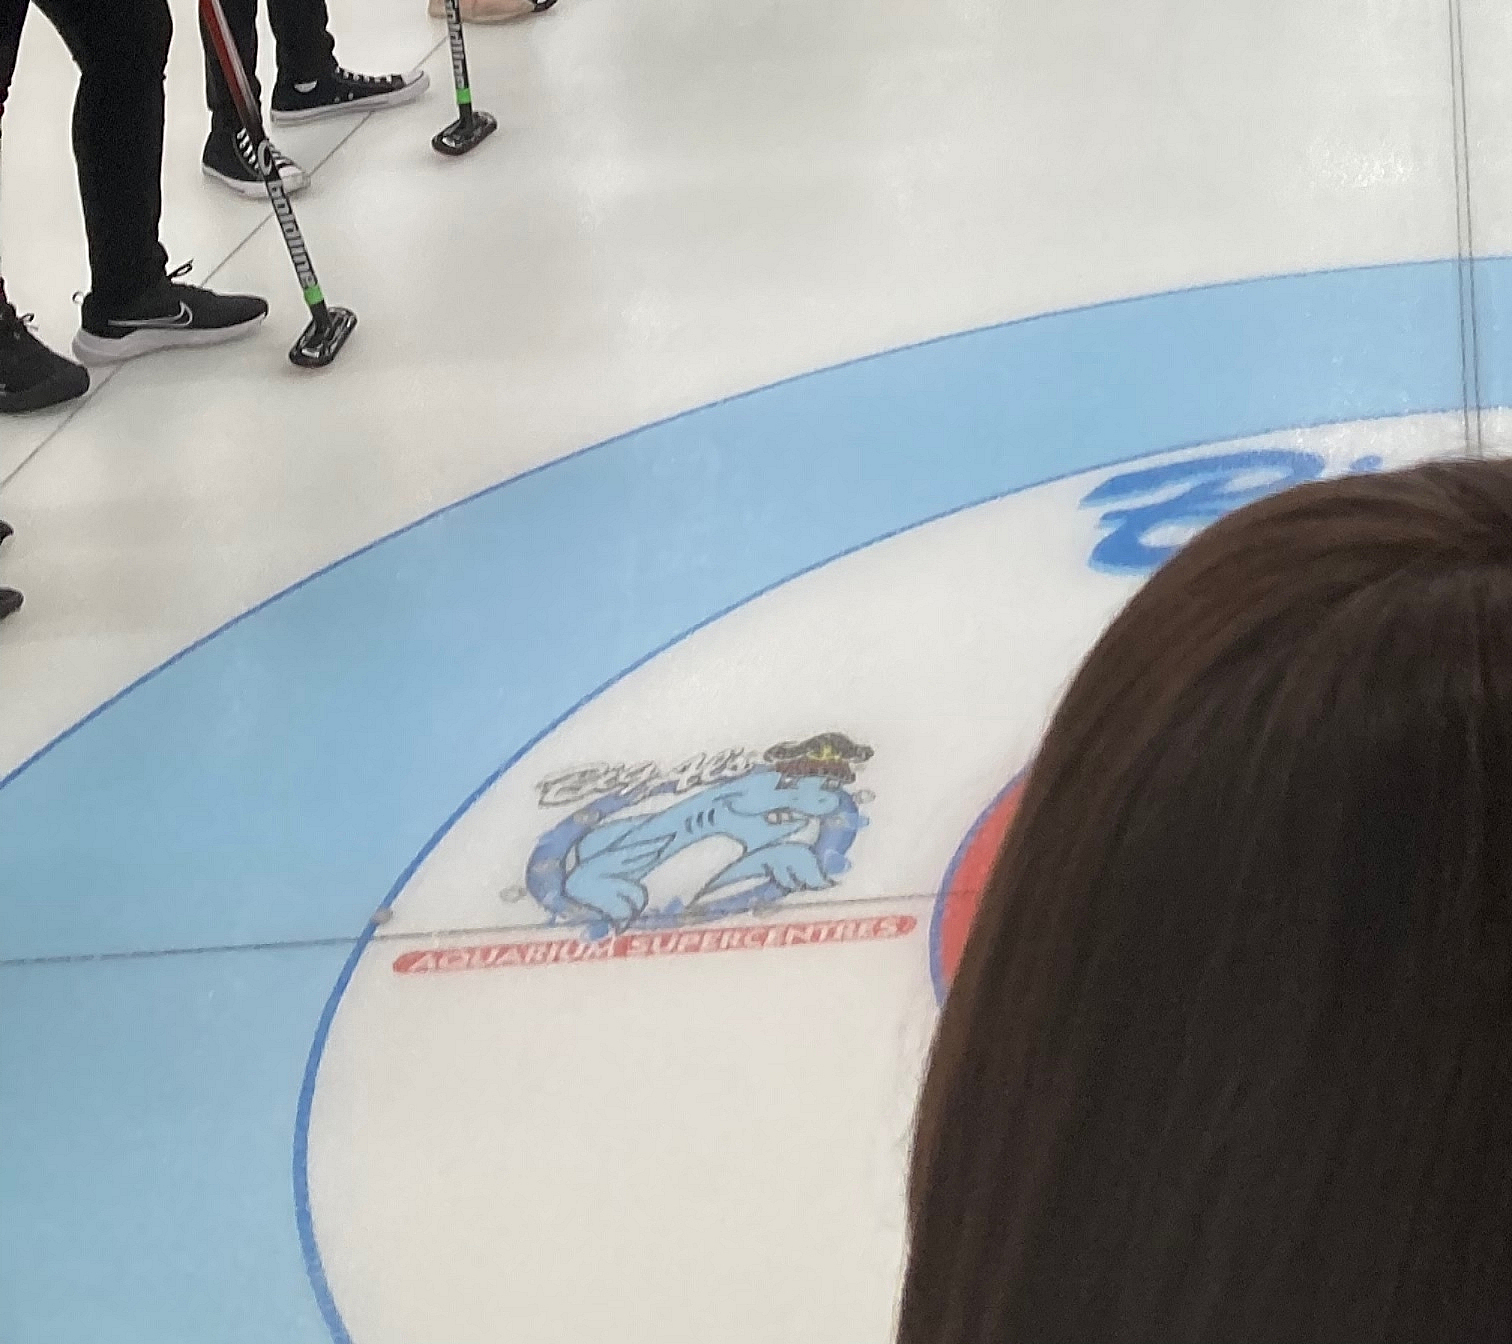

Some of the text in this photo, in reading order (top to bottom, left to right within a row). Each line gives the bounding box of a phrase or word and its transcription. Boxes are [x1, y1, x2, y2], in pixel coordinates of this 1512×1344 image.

[266, 179, 319, 290] Goldline
[412, 917, 903, 973] AQUARIUM SUPERCENTRES
